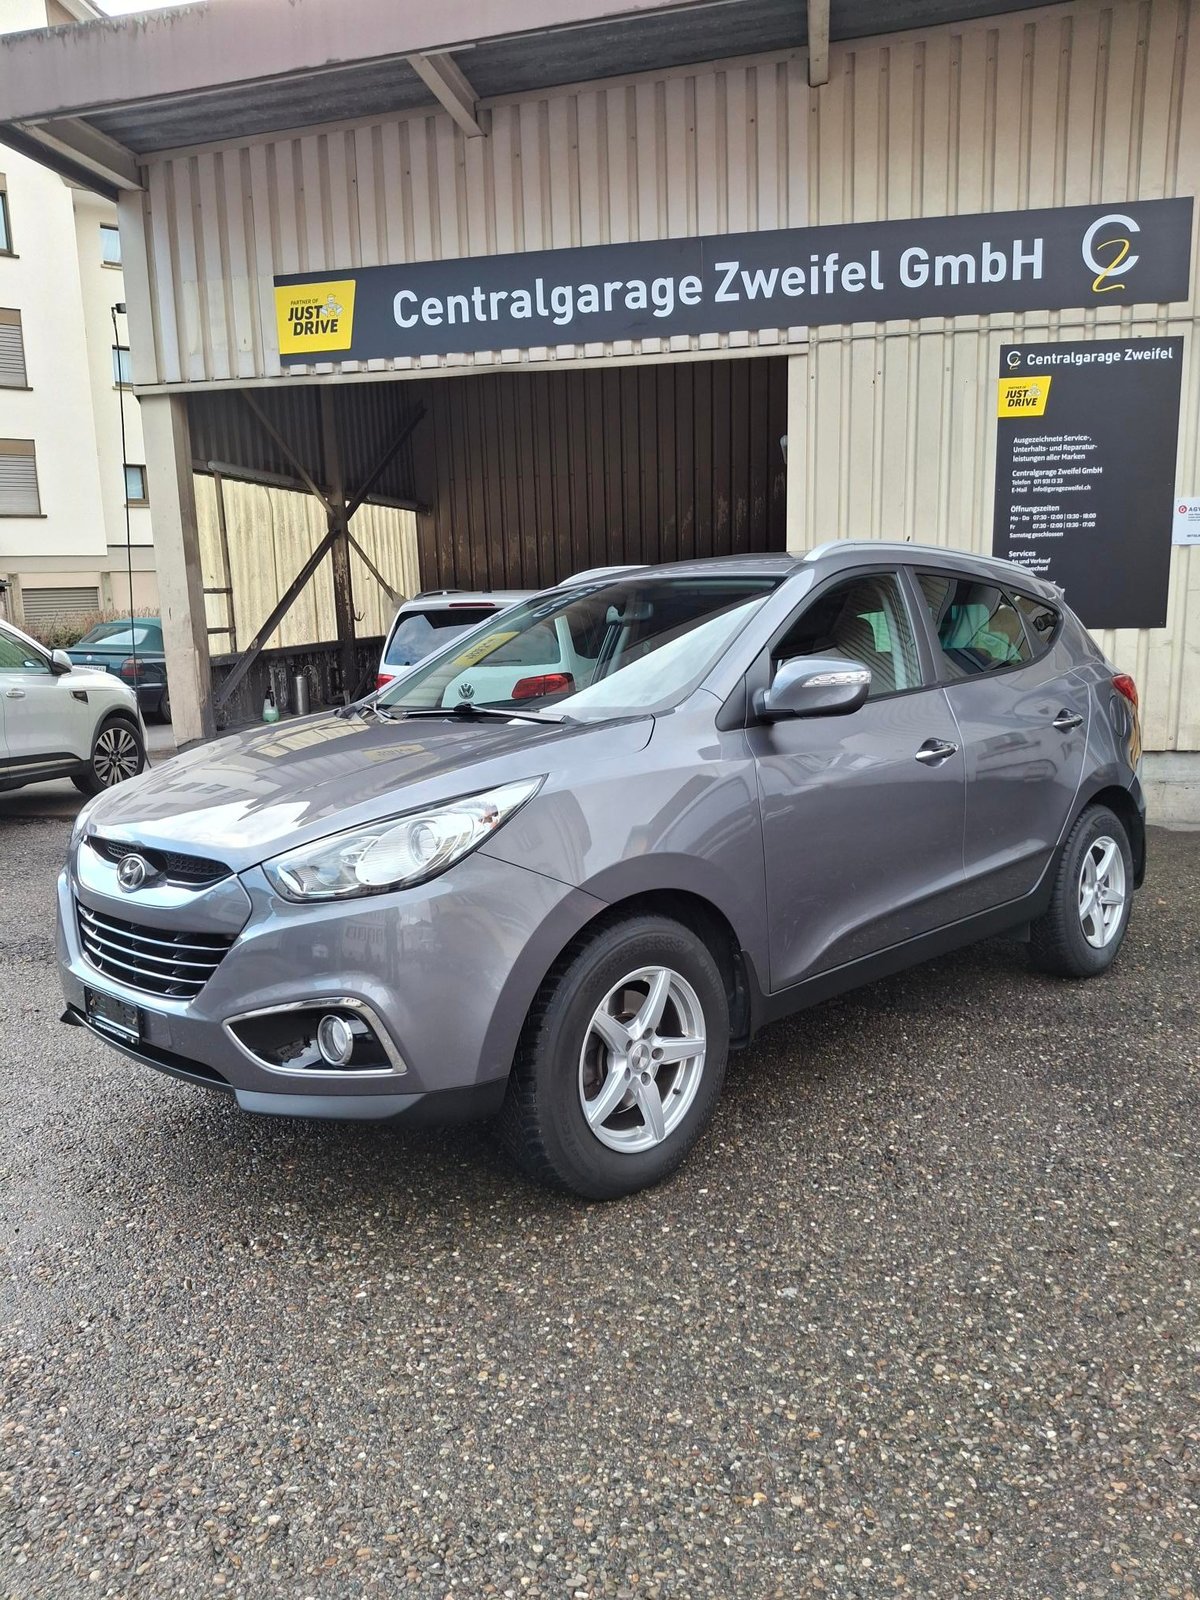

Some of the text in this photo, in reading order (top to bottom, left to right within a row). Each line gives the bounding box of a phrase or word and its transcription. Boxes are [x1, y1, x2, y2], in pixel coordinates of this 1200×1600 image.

[393, 238, 1044, 328] Centralgarage Zweifel GmbH
[288, 305, 323, 321] JUST
[293, 319, 339, 336] DRIVE
[1026, 347, 1173, 366] Centralgarage Zweifel
[1005, 389, 1029, 399] JUST
[1007, 397, 1038, 407] DRIVE
[1013, 436, 1063, 445] Ausgezeichnete
[1013, 444, 1098, 453] Unterhalts- und Reparatur-
[1012, 454, 1046, 463] leistungen
[1012, 466, 1103, 478] Centralgarage Zweifel GmbH
[1010, 505, 1060, 513] Öffnungszeiten
